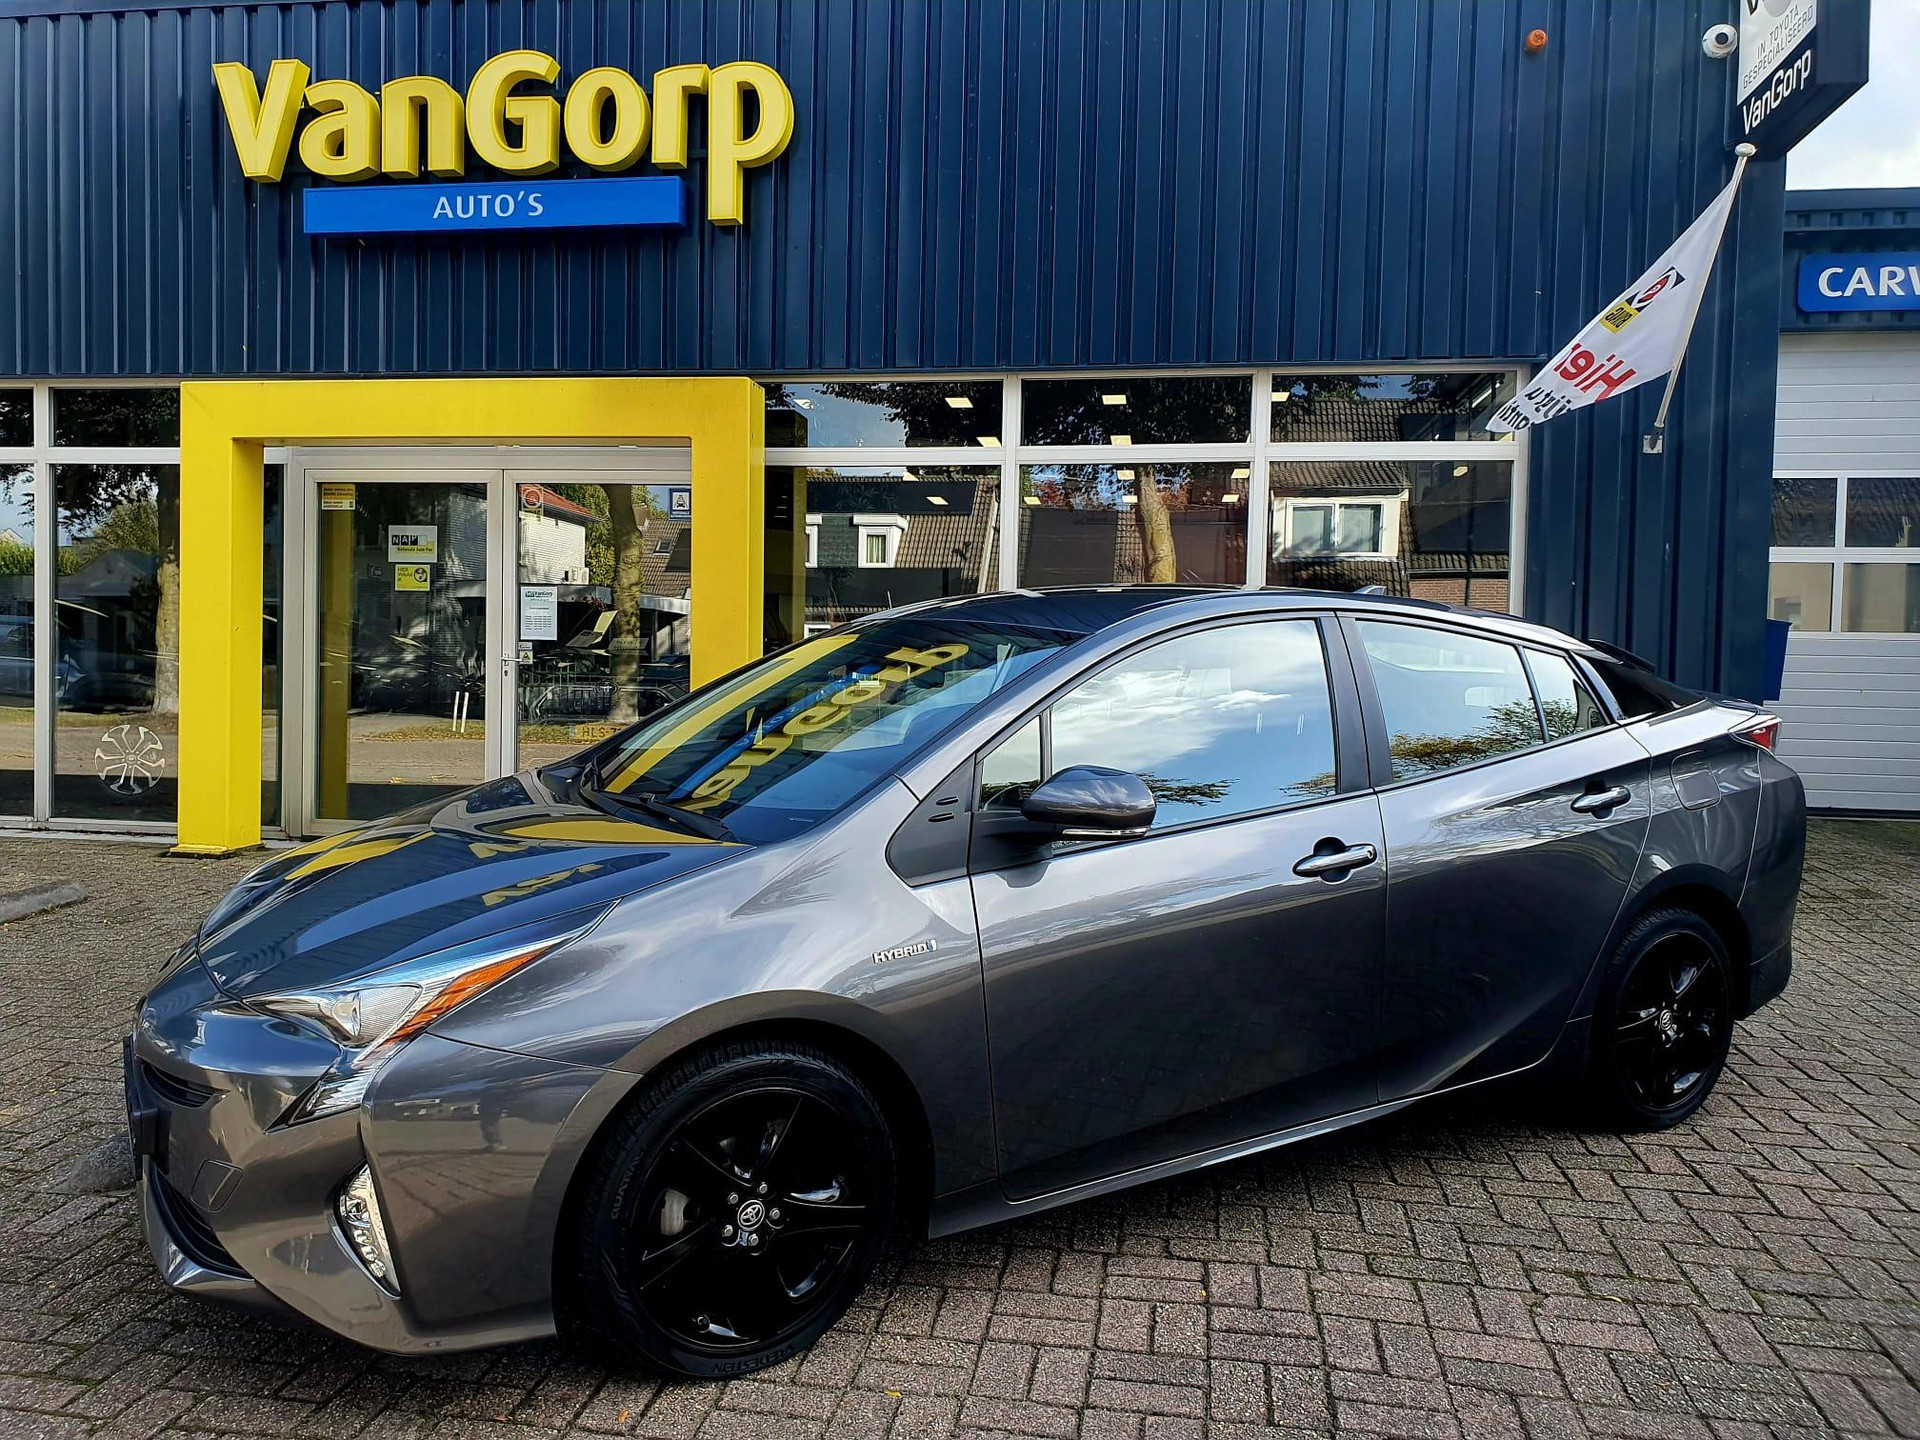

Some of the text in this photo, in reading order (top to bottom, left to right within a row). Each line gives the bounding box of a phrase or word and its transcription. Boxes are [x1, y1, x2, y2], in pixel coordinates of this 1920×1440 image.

[1742, 4, 1814, 90] GESPECIALISEERD
[1757, 4, 1800, 59] IN TOYOTA
[1742, 48, 1812, 136] VanGorp
[212, 49, 795, 226] VanGorp
[432, 190, 545, 219] AUTO'S
[392, 535, 418, 545] NAP
[872, 943, 927, 964] HYBRID
